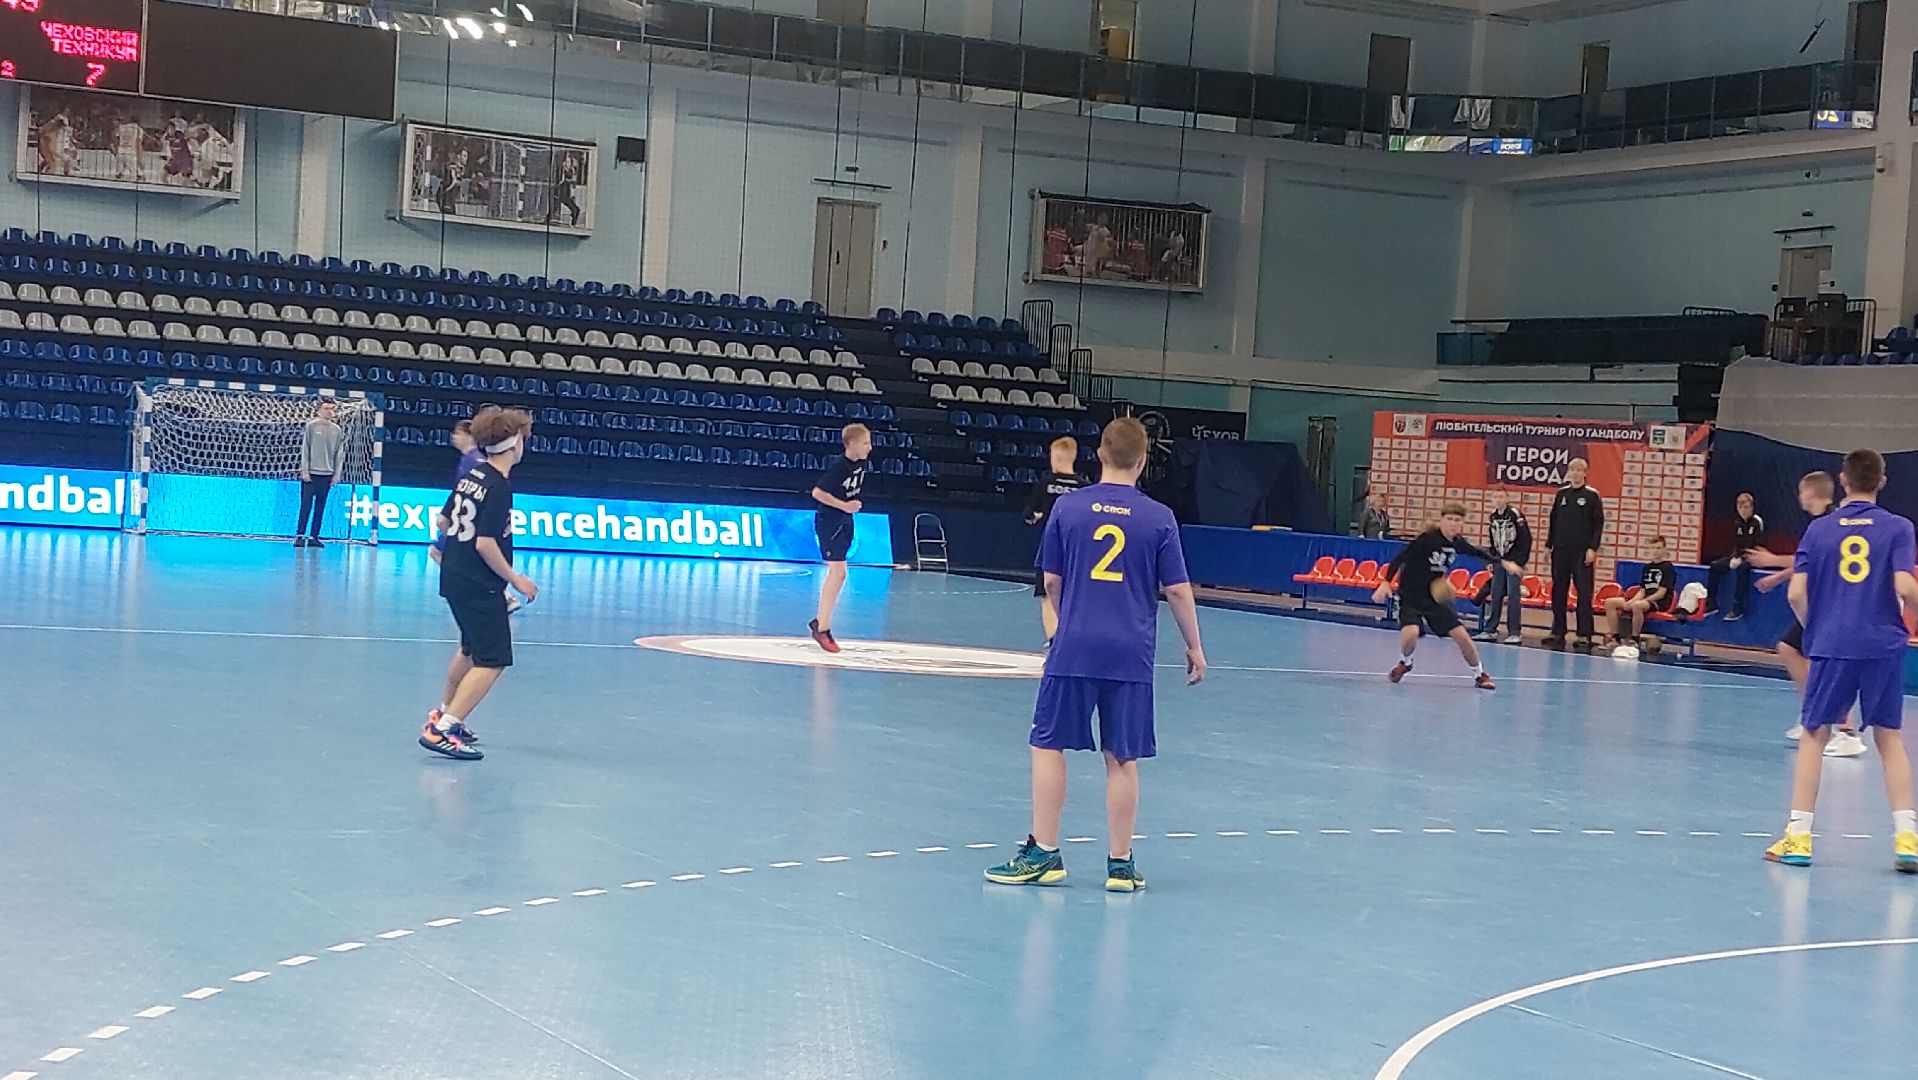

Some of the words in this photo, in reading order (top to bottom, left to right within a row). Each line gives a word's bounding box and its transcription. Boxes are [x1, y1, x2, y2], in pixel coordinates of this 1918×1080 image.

[51, 38, 138, 62] ТЕХНИКУМ
[86, 61, 106, 87] 7
[1435, 421, 1523, 434] ЛЮБИТЕЛЬСКИЙ
[1525, 425, 1566, 436] ТУРНИР
[1568, 427, 1585, 438] ПО
[1585, 428, 1645, 440] ГАНДБОЛУ
[1506, 446, 1569, 465] ГЕРОИ
[1091, 524, 1125, 581] 2
[1839, 535, 1870, 583] 8
